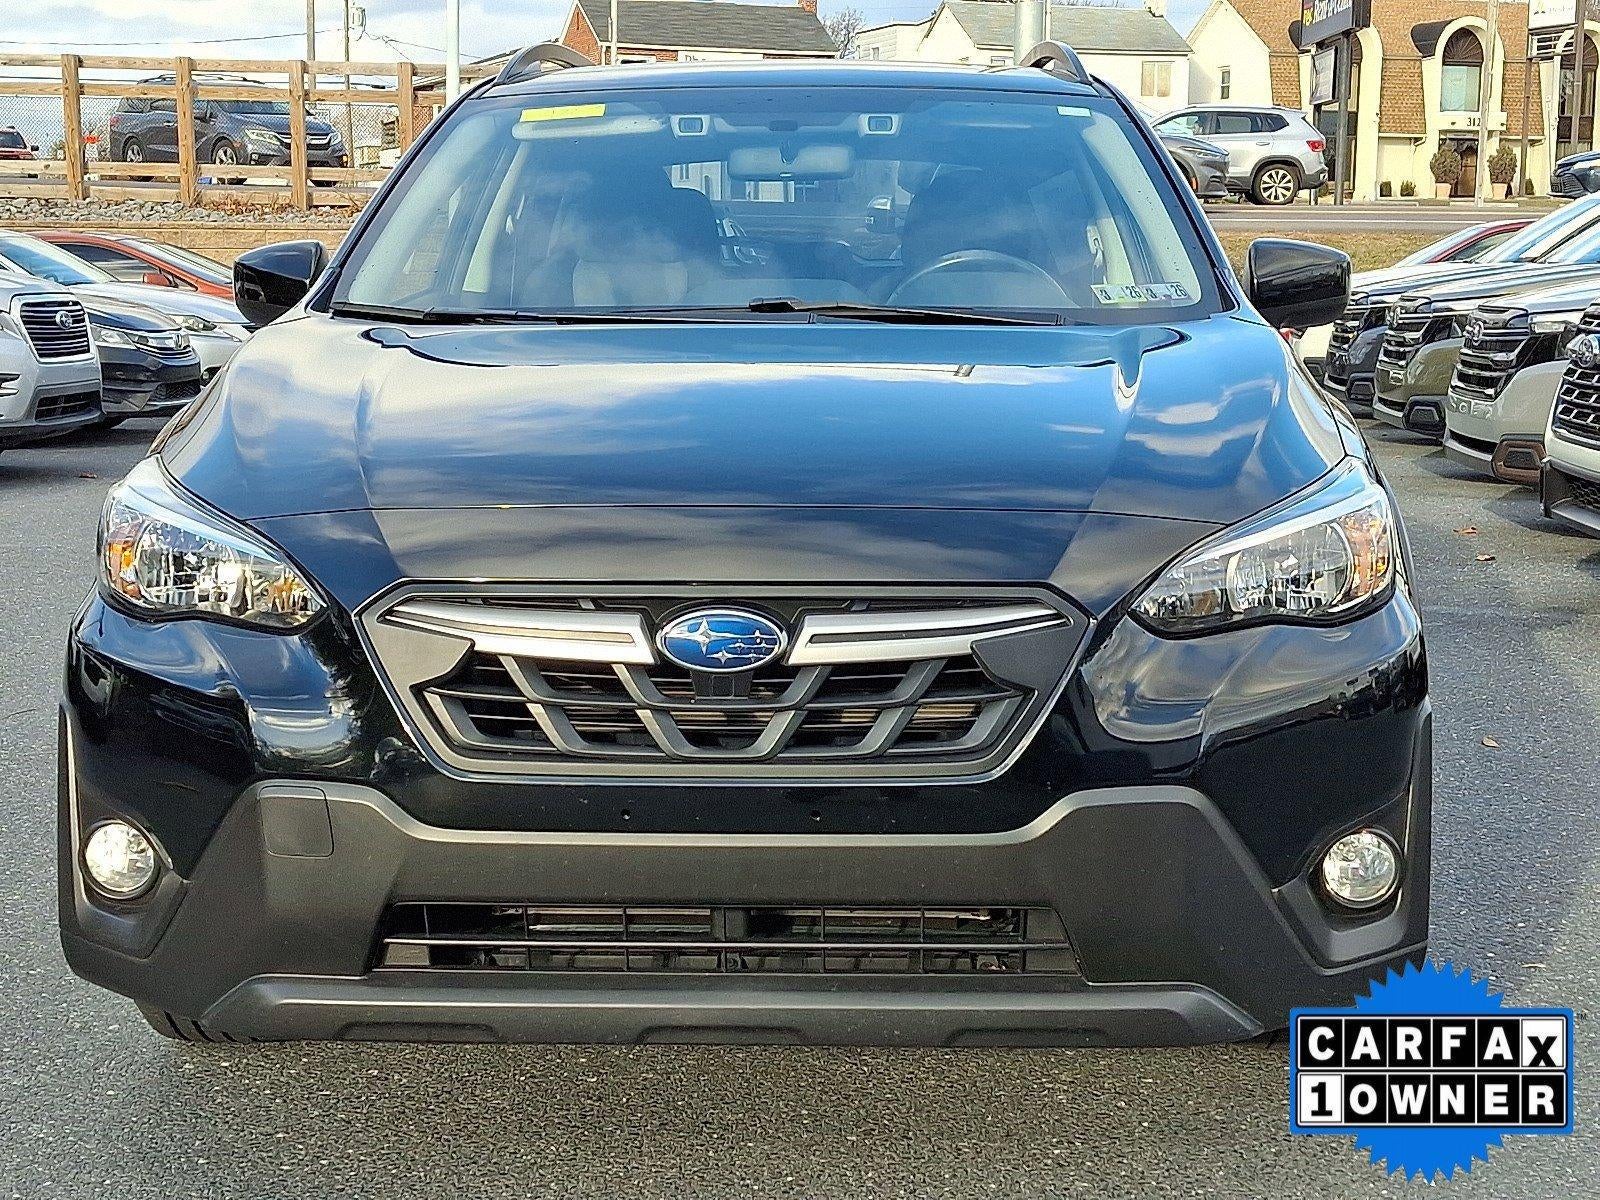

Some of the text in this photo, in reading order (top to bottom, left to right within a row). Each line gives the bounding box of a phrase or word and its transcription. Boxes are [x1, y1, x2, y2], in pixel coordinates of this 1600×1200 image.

[1100, 288, 1112, 300] 3
[1145, 284, 1188, 299] 3 26
